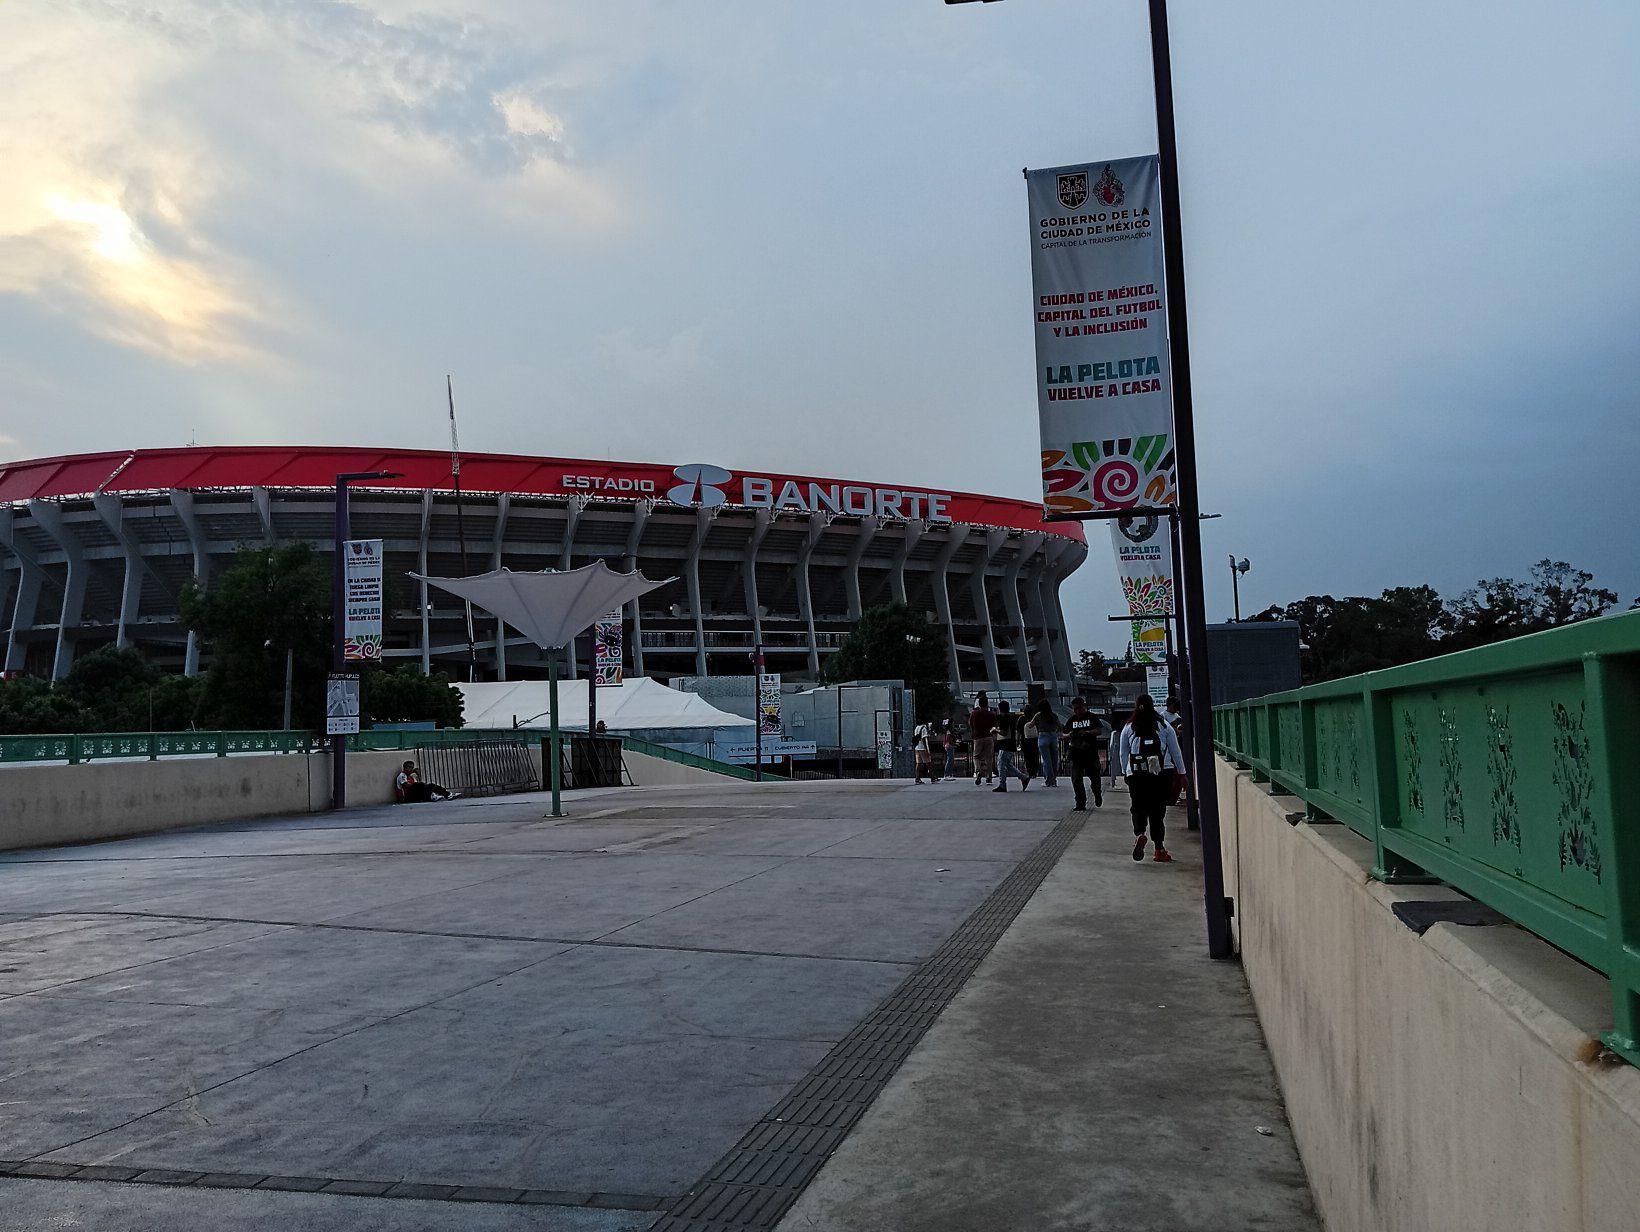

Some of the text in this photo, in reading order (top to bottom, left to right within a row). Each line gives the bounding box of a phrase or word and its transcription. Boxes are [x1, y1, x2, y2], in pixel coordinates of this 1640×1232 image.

[1040, 207, 1150, 228] GOBIERNO DE LA
[1040, 219, 1151, 239] CIUDAD DE MÉXICO
[1041, 231, 1152, 249] CAPITAL DE LA TRANSFORMACIÓN
[1040, 284, 1158, 306] CIUDAD DE MÉXICO,
[1037, 310, 1086, 322] CAPITAL
[1089, 307, 1113, 319] DEL
[1053, 317, 1148, 338] Y LA INCLUSIÓN
[1046, 356, 1160, 384] LA PELOTA
[1047, 379, 1162, 401] VUELVE A CASA
[562, 474, 655, 492] ESTADIO
[742, 476, 952, 522] BANORTE
[1120, 546, 1160, 554] LA PELOTA
[1072, 720, 1090, 729] B&W
